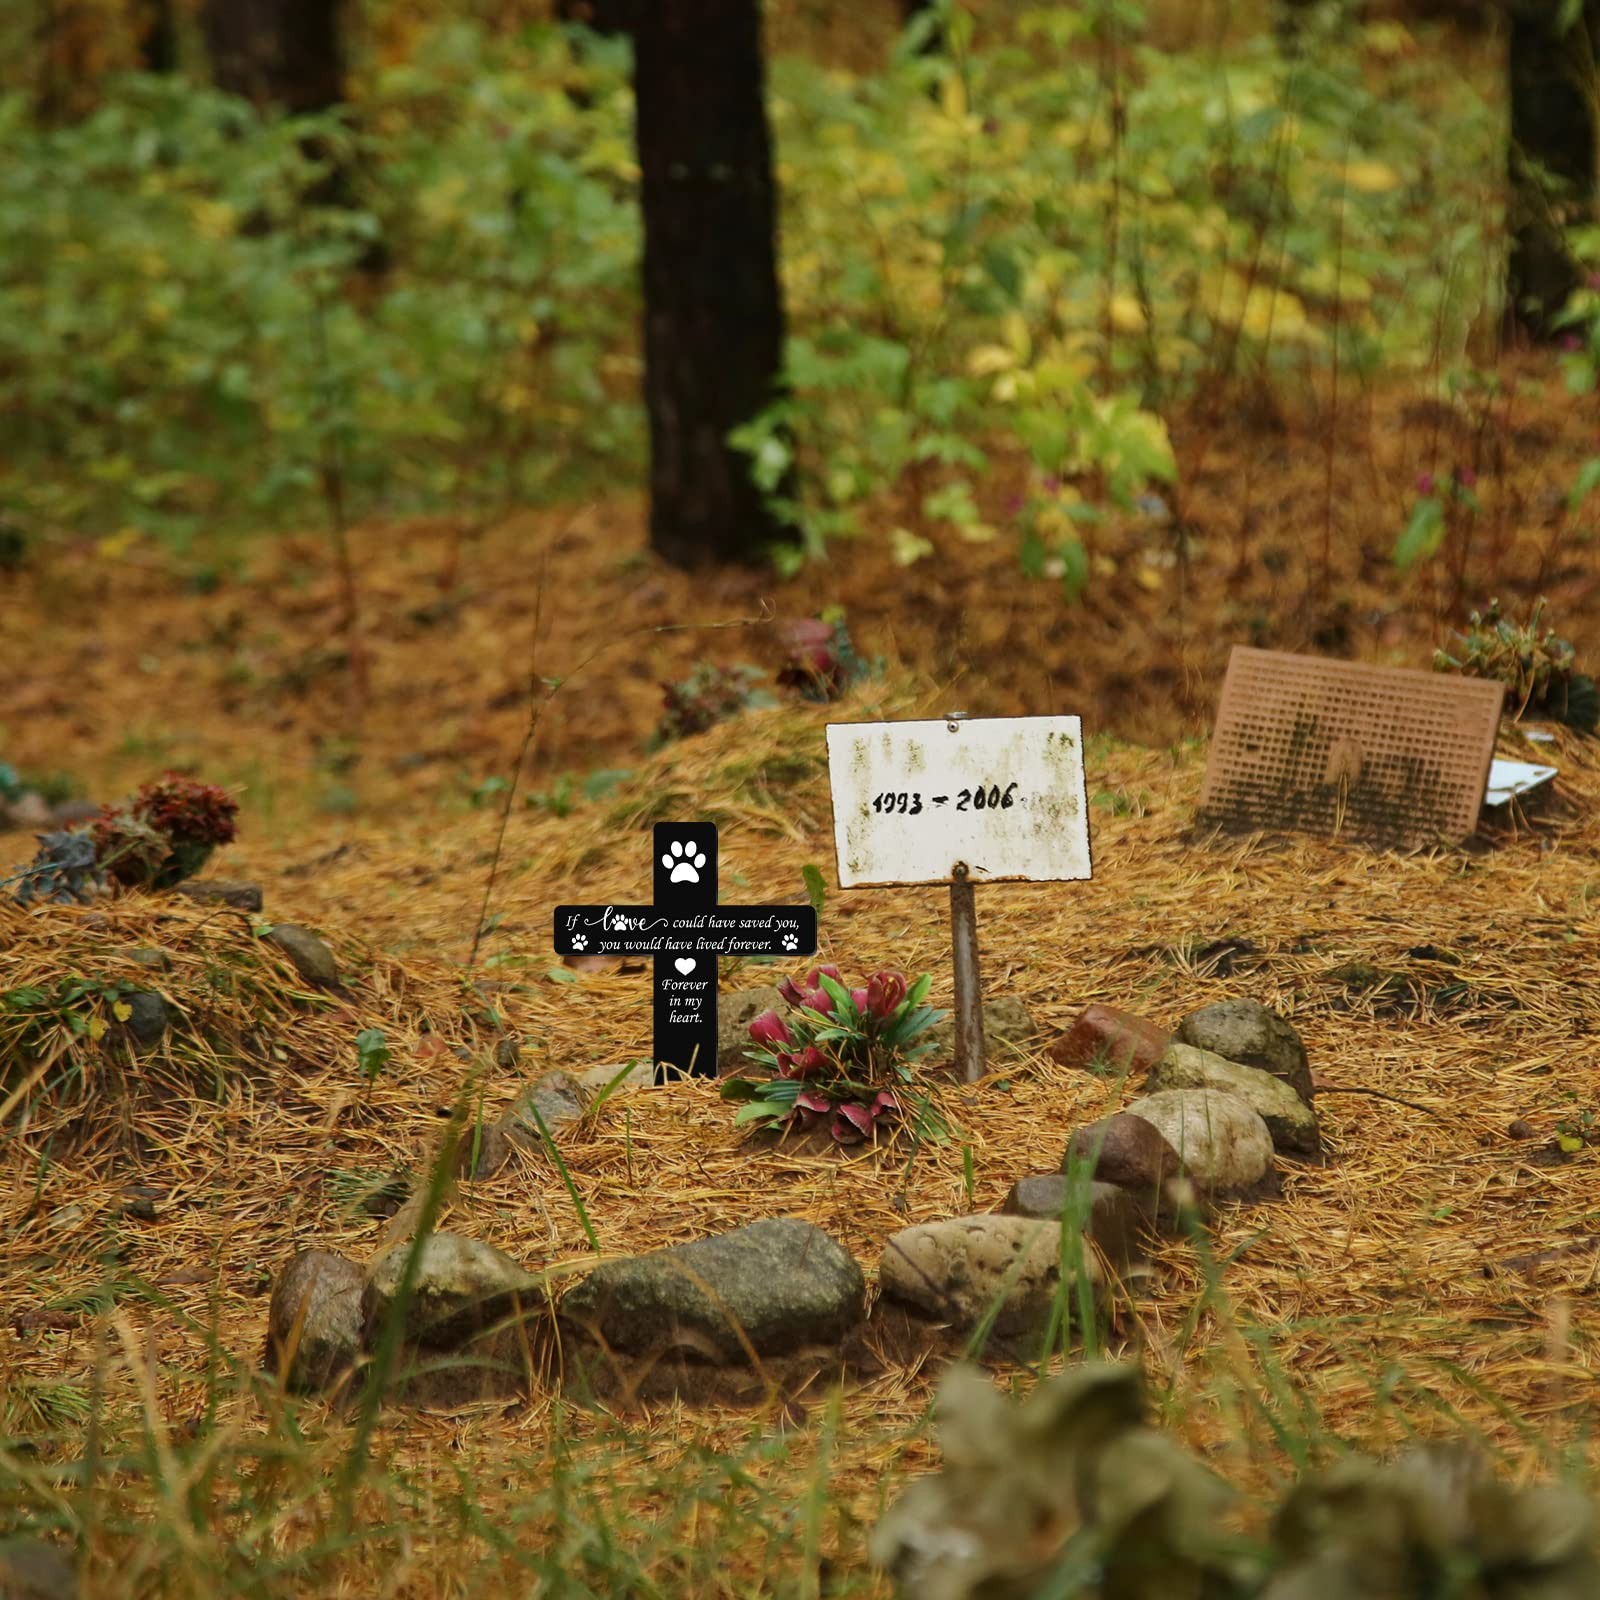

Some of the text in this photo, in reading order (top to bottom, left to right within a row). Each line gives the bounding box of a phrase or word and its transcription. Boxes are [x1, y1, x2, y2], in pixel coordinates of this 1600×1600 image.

[873, 792, 923, 815] 1993
[957, 782, 1018, 811] 2006
[565, 914, 580, 930] If
[673, 915, 706, 929] could
[709, 915, 736, 929] have
[739, 915, 773, 929] saved
[774, 919, 799, 932] you,
[598, 936, 772, 954] you would have lived forever.
[661, 979, 708, 991] Forever
[669, 995, 702, 1010] in my
[669, 1011, 703, 1023] heart.
